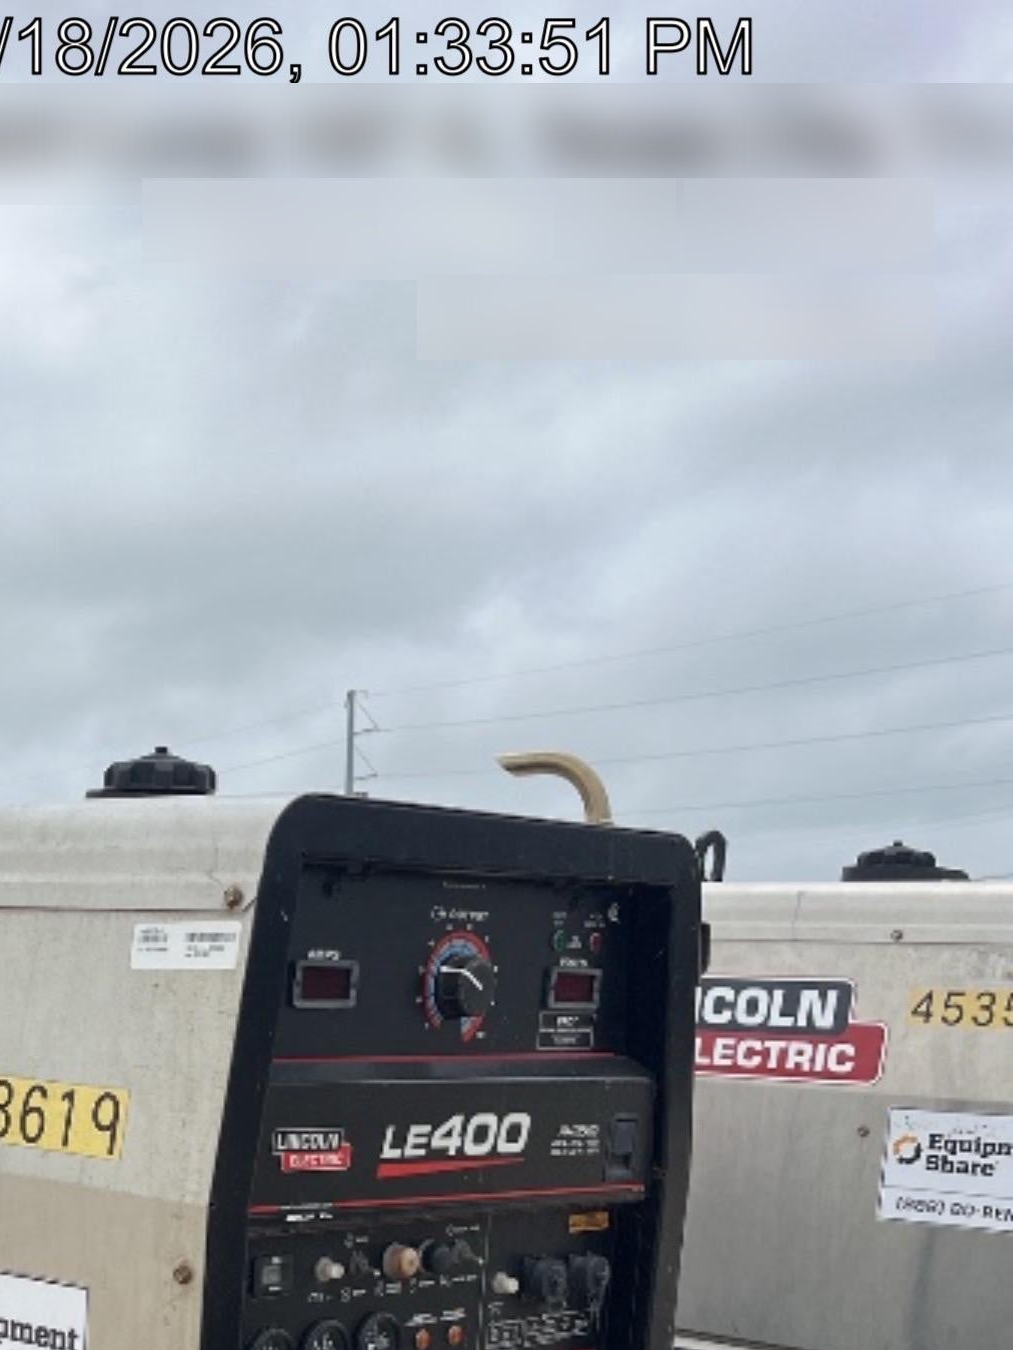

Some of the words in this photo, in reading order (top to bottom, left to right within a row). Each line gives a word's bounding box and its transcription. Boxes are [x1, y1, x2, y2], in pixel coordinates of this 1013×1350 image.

[694, 985, 839, 1030] COLN
[694, 1037, 856, 1073] LECTRIC
[379, 1112, 532, 1158] LE400
